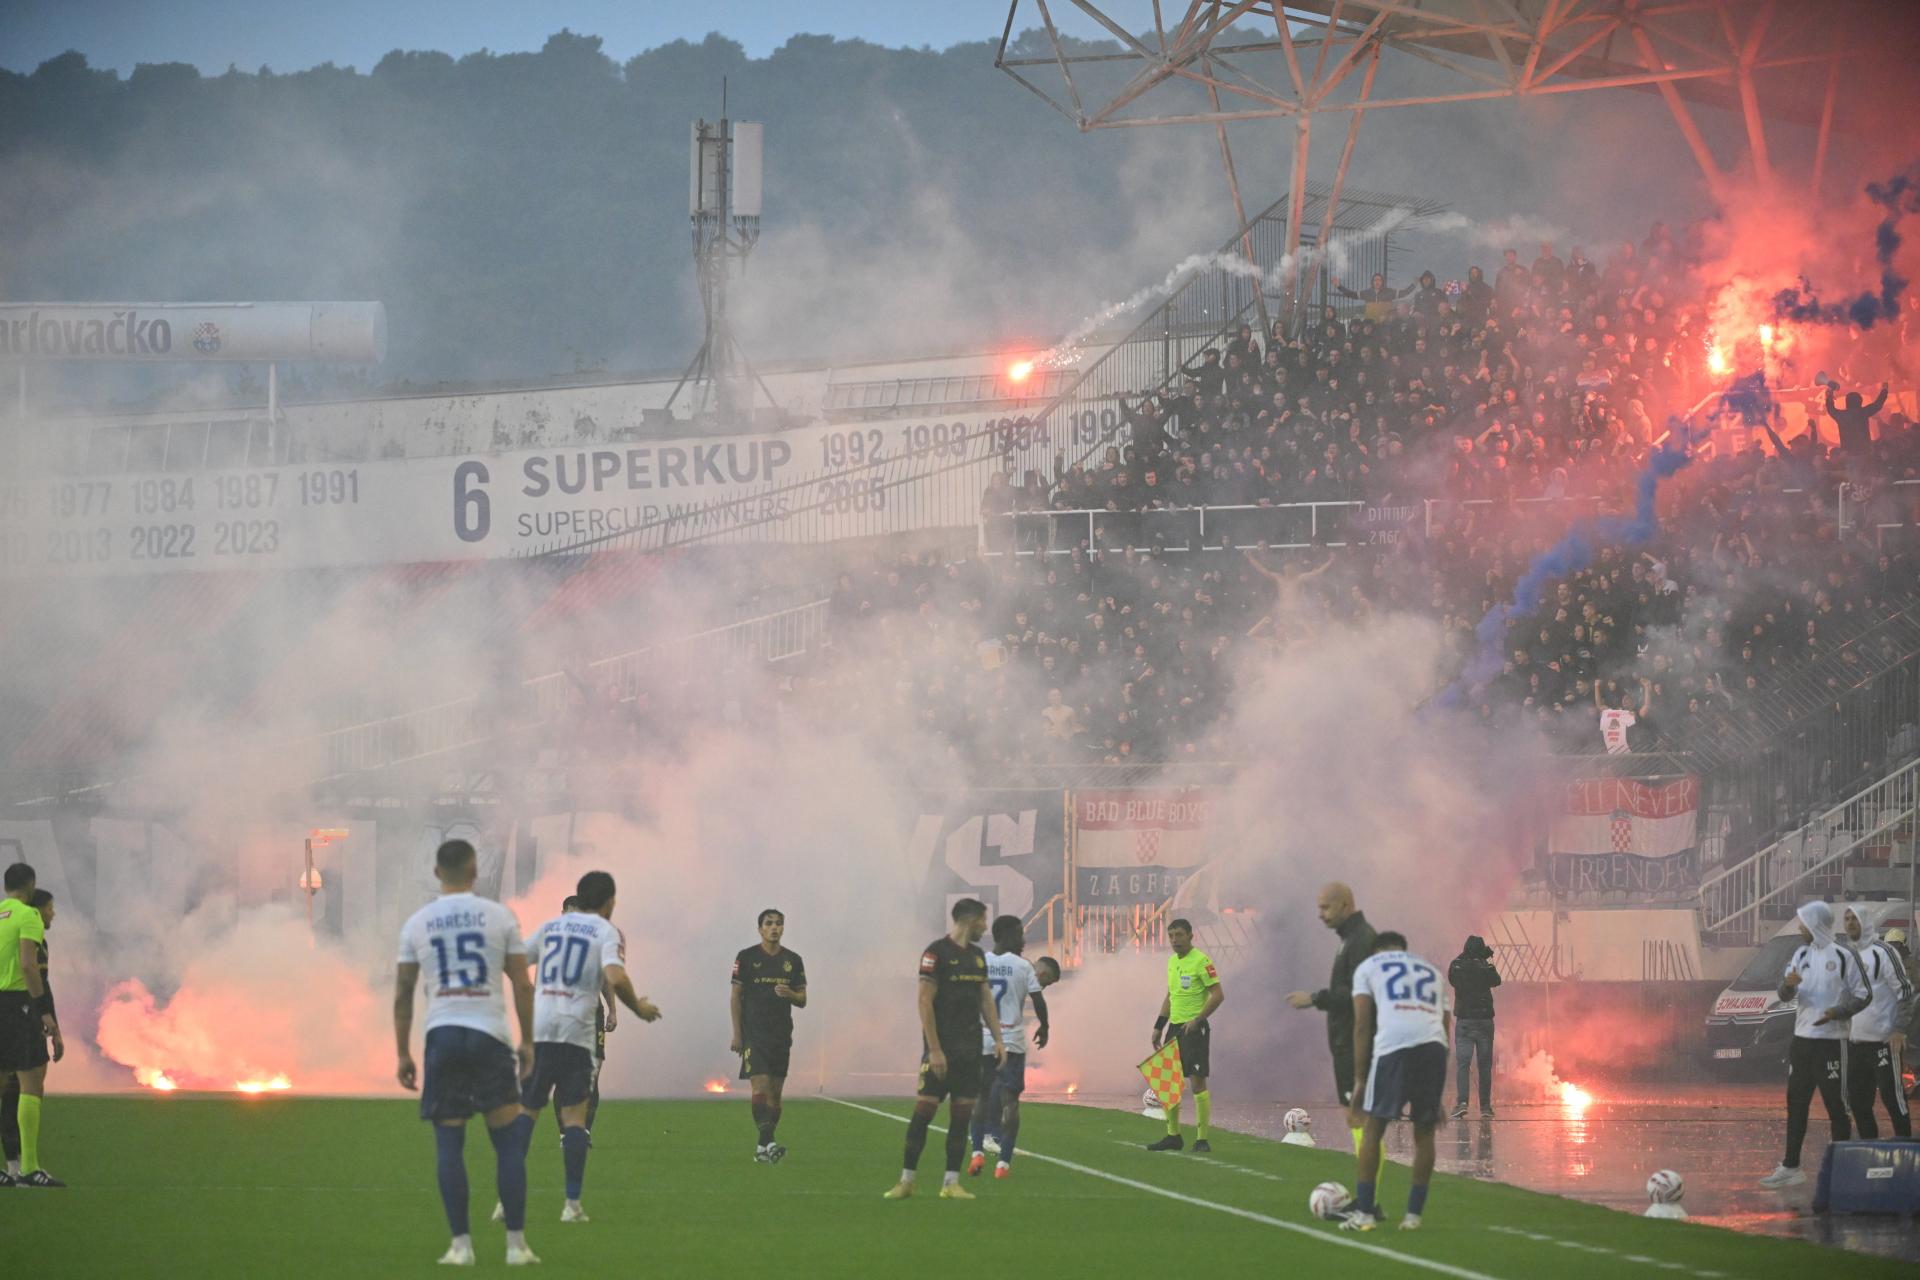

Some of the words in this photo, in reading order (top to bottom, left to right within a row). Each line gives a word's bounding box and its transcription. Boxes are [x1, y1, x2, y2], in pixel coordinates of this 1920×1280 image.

[521, 439, 792, 498] SUPERKUP
[819, 429, 885, 468] 1992
[130, 477, 195, 514] 1984
[214, 473, 280, 509] 1987
[298, 469, 360, 507] 1991
[453, 460, 491, 543] 6
[516, 505, 661, 538] SUPERCUP
[666, 497, 792, 527] WINNERS
[130, 523, 196, 558] 2022
[213, 519, 280, 554] 2023
[1085, 801, 1120, 823] BAD
[1125, 799, 1167, 821] BLUE
[1168, 801, 1209, 825] BOYS
[1616, 778, 1692, 816] NEVER
[1551, 854, 1690, 891] URRENDER
[430, 931, 488, 988] 15
[541, 935, 590, 987] 20
[988, 965, 1014, 977] AMBA
[1380, 961, 1437, 1006] 22
